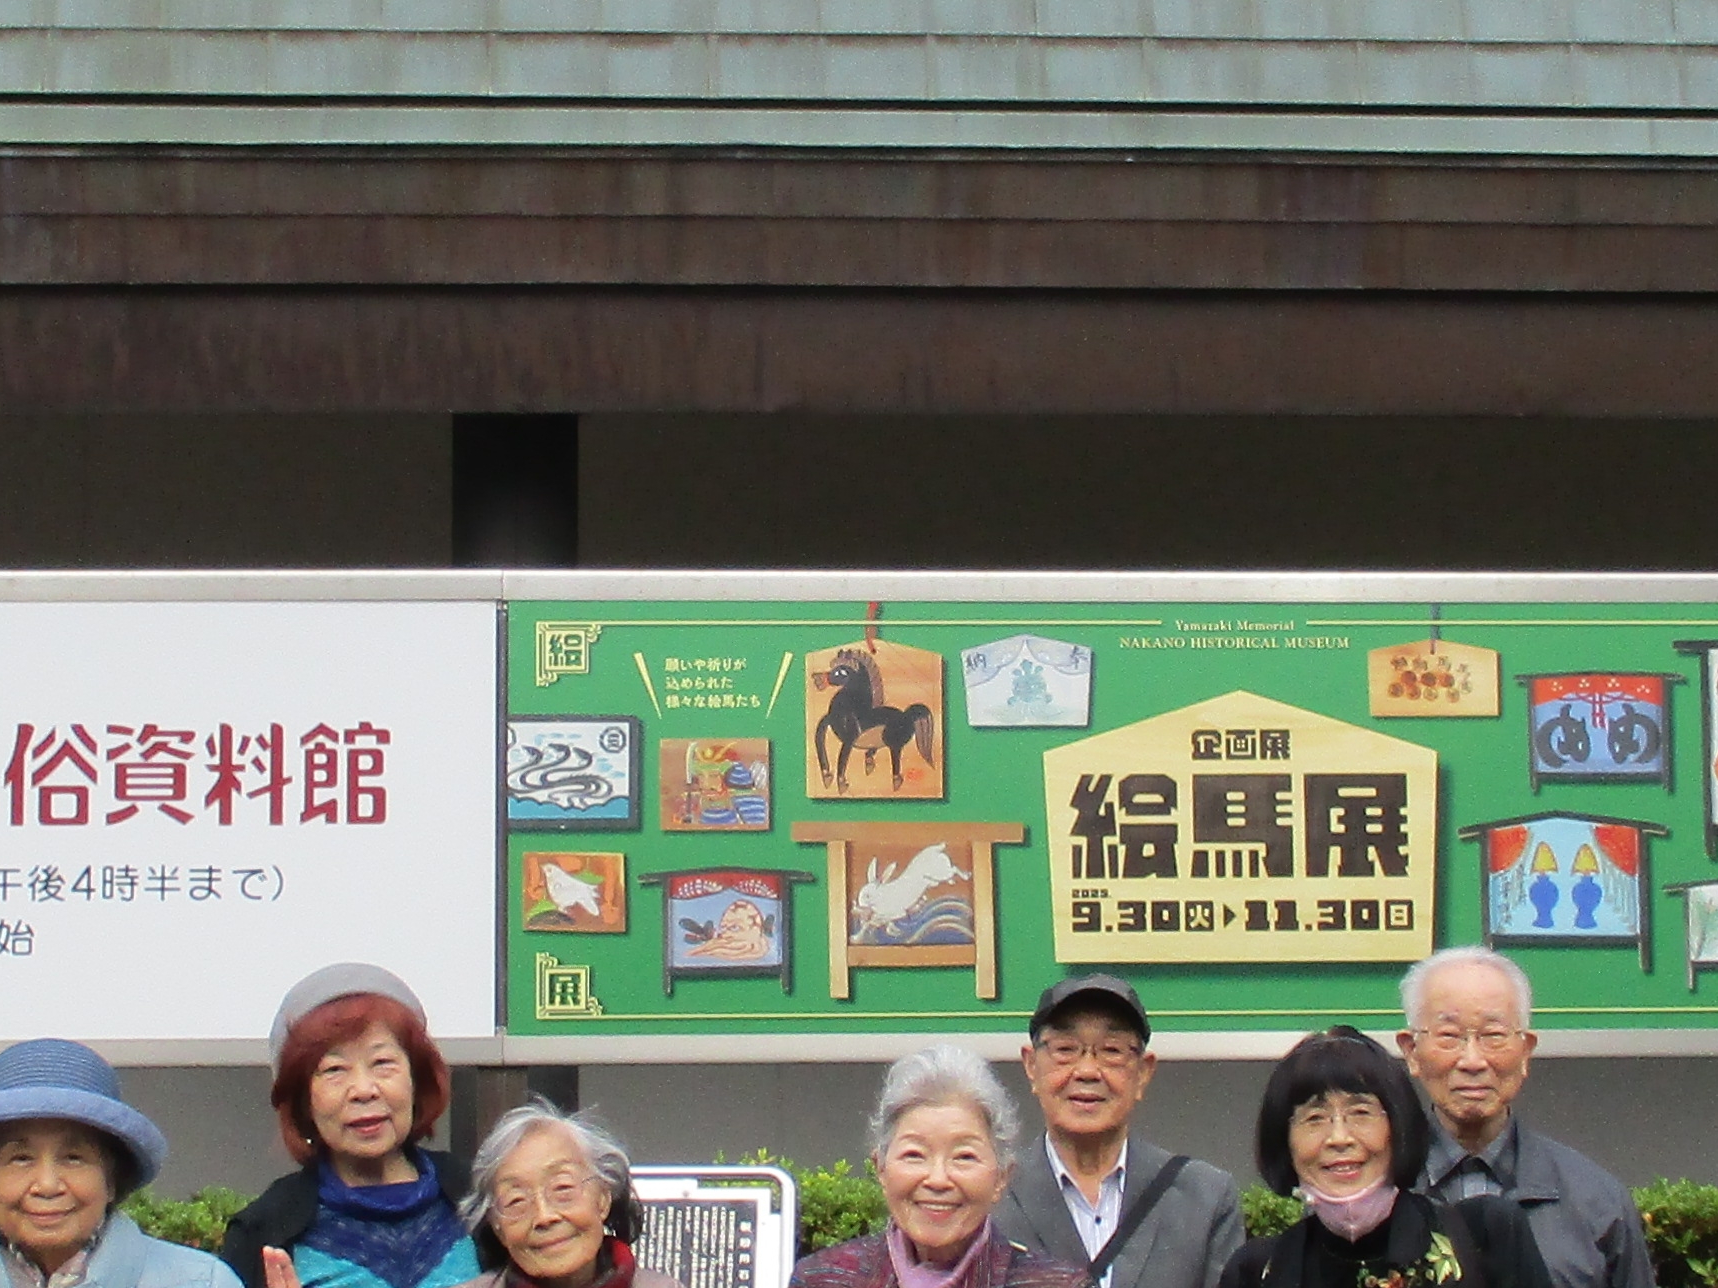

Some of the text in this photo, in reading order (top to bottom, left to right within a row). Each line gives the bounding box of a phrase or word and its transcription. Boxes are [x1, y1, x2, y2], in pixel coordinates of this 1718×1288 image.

[1175, 619, 1295, 632] Yamazaki Memorial
[1119, 636, 1350, 650] NAKANO HISTORICAL MUSEUM
[665, 657, 747, 673] 願いや祈りが
[665, 676, 734, 691] 込められた
[665, 693, 761, 709] 様々な絵馬たち
[1191, 729, 1291, 762] 企画展
[1068, 772, 1410, 880] 絵馬展
